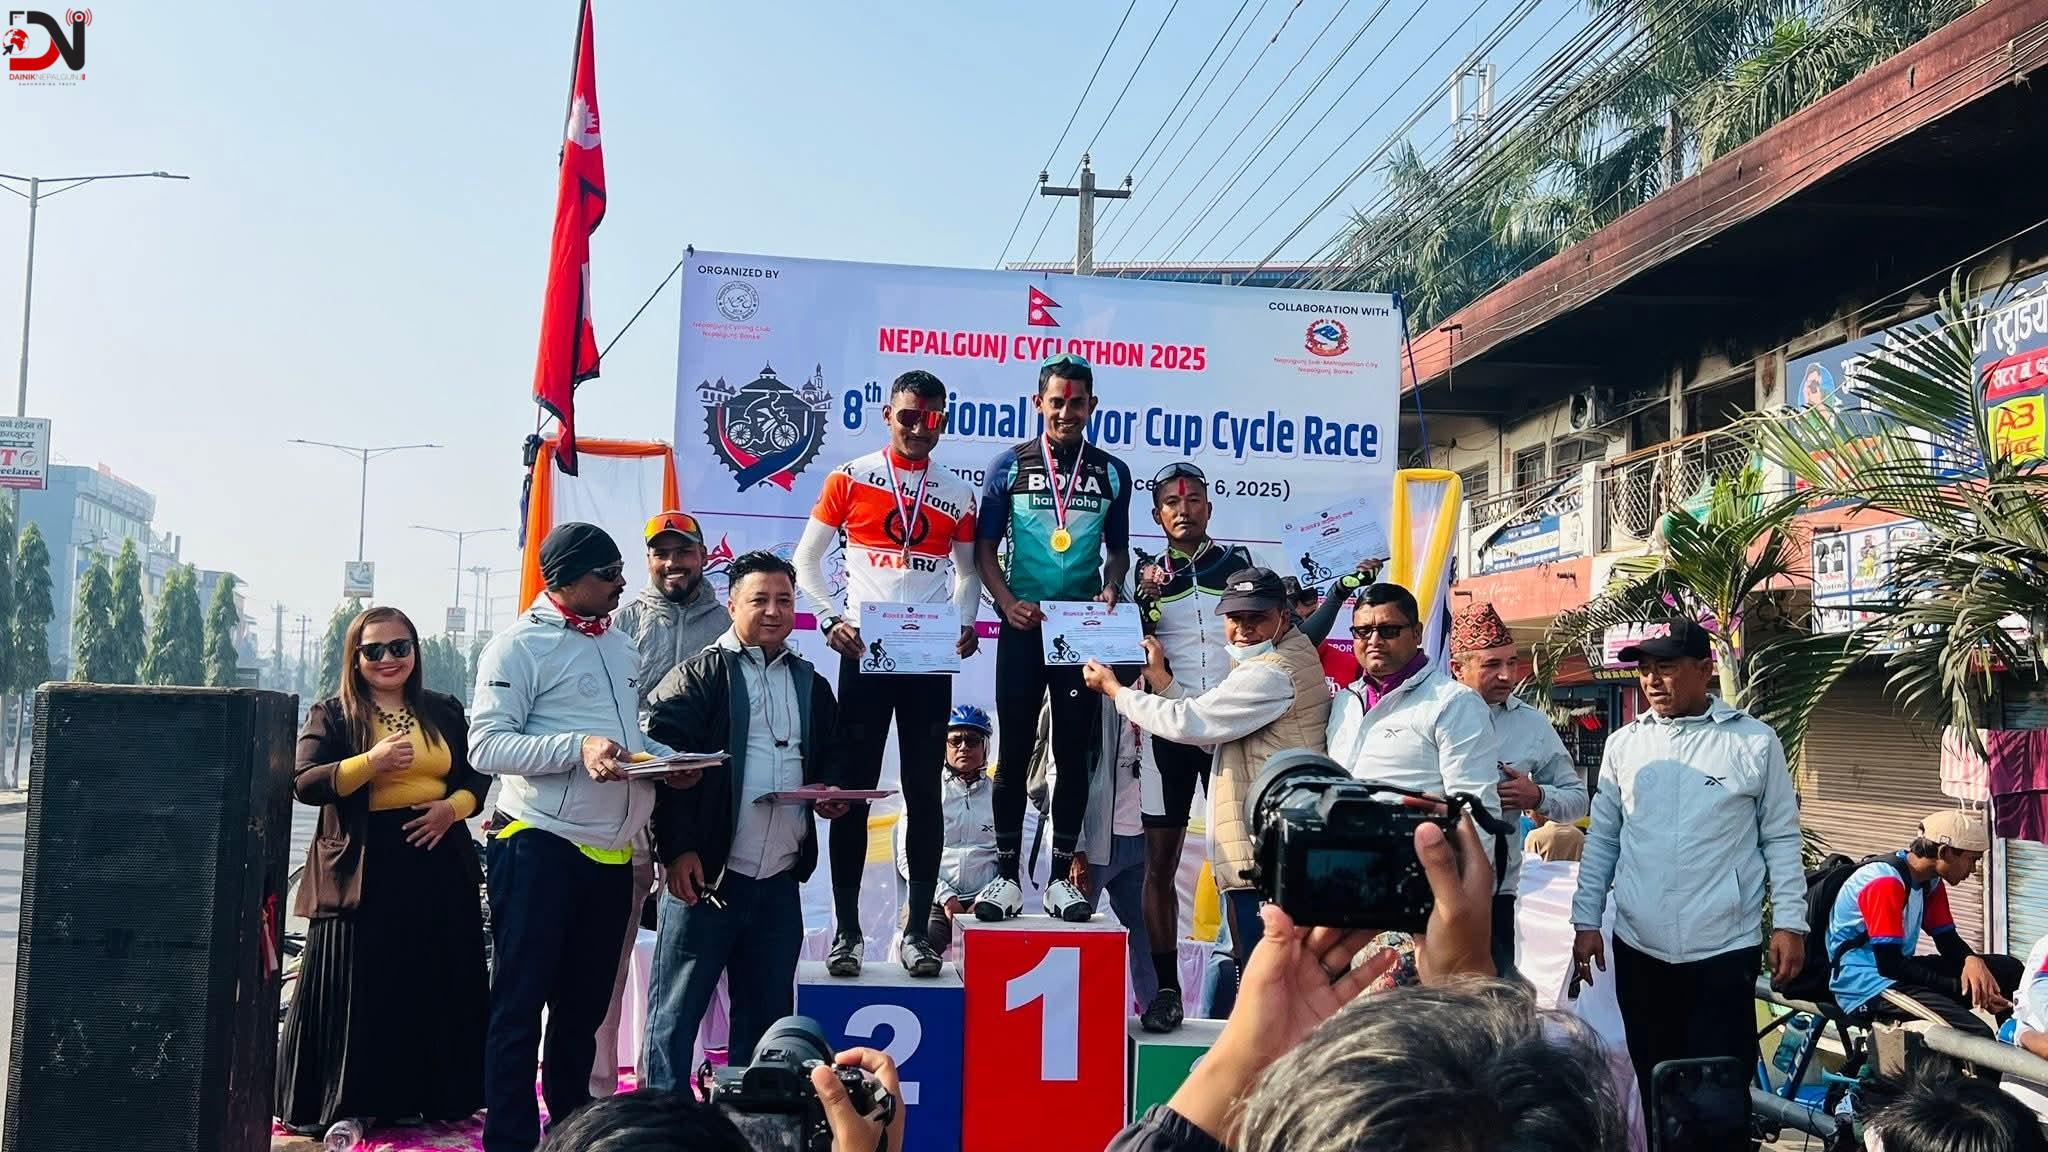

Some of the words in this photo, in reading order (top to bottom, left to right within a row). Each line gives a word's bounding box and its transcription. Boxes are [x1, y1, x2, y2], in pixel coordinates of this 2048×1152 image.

[697, 265, 763, 278] ORGANIZED
[765, 270, 780, 279] BY
[1268, 302, 1358, 315] COLLABORATION
[1361, 308, 1389, 317] WITH
[878, 327, 1008, 364] NEPALGUNJ
[1013, 335, 1144, 368] CYCLOTHON
[1150, 344, 1207, 371] 2025
[843, 381, 882, 430] 8th
[941, 392, 1027, 439] ional
[1146, 407, 1203, 456] Cup
[1212, 410, 1295, 459] Cycle
[1303, 415, 1378, 459] Race
[868, 472, 887, 487] to
[900, 480, 919, 498] he
[924, 492, 962, 520] roots
[1215, 480, 1231, 498] 6,
[1235, 479, 1291, 503] 2025)
[1005, 947, 1081, 1082] 1
[843, 1004, 923, 1105] 2
